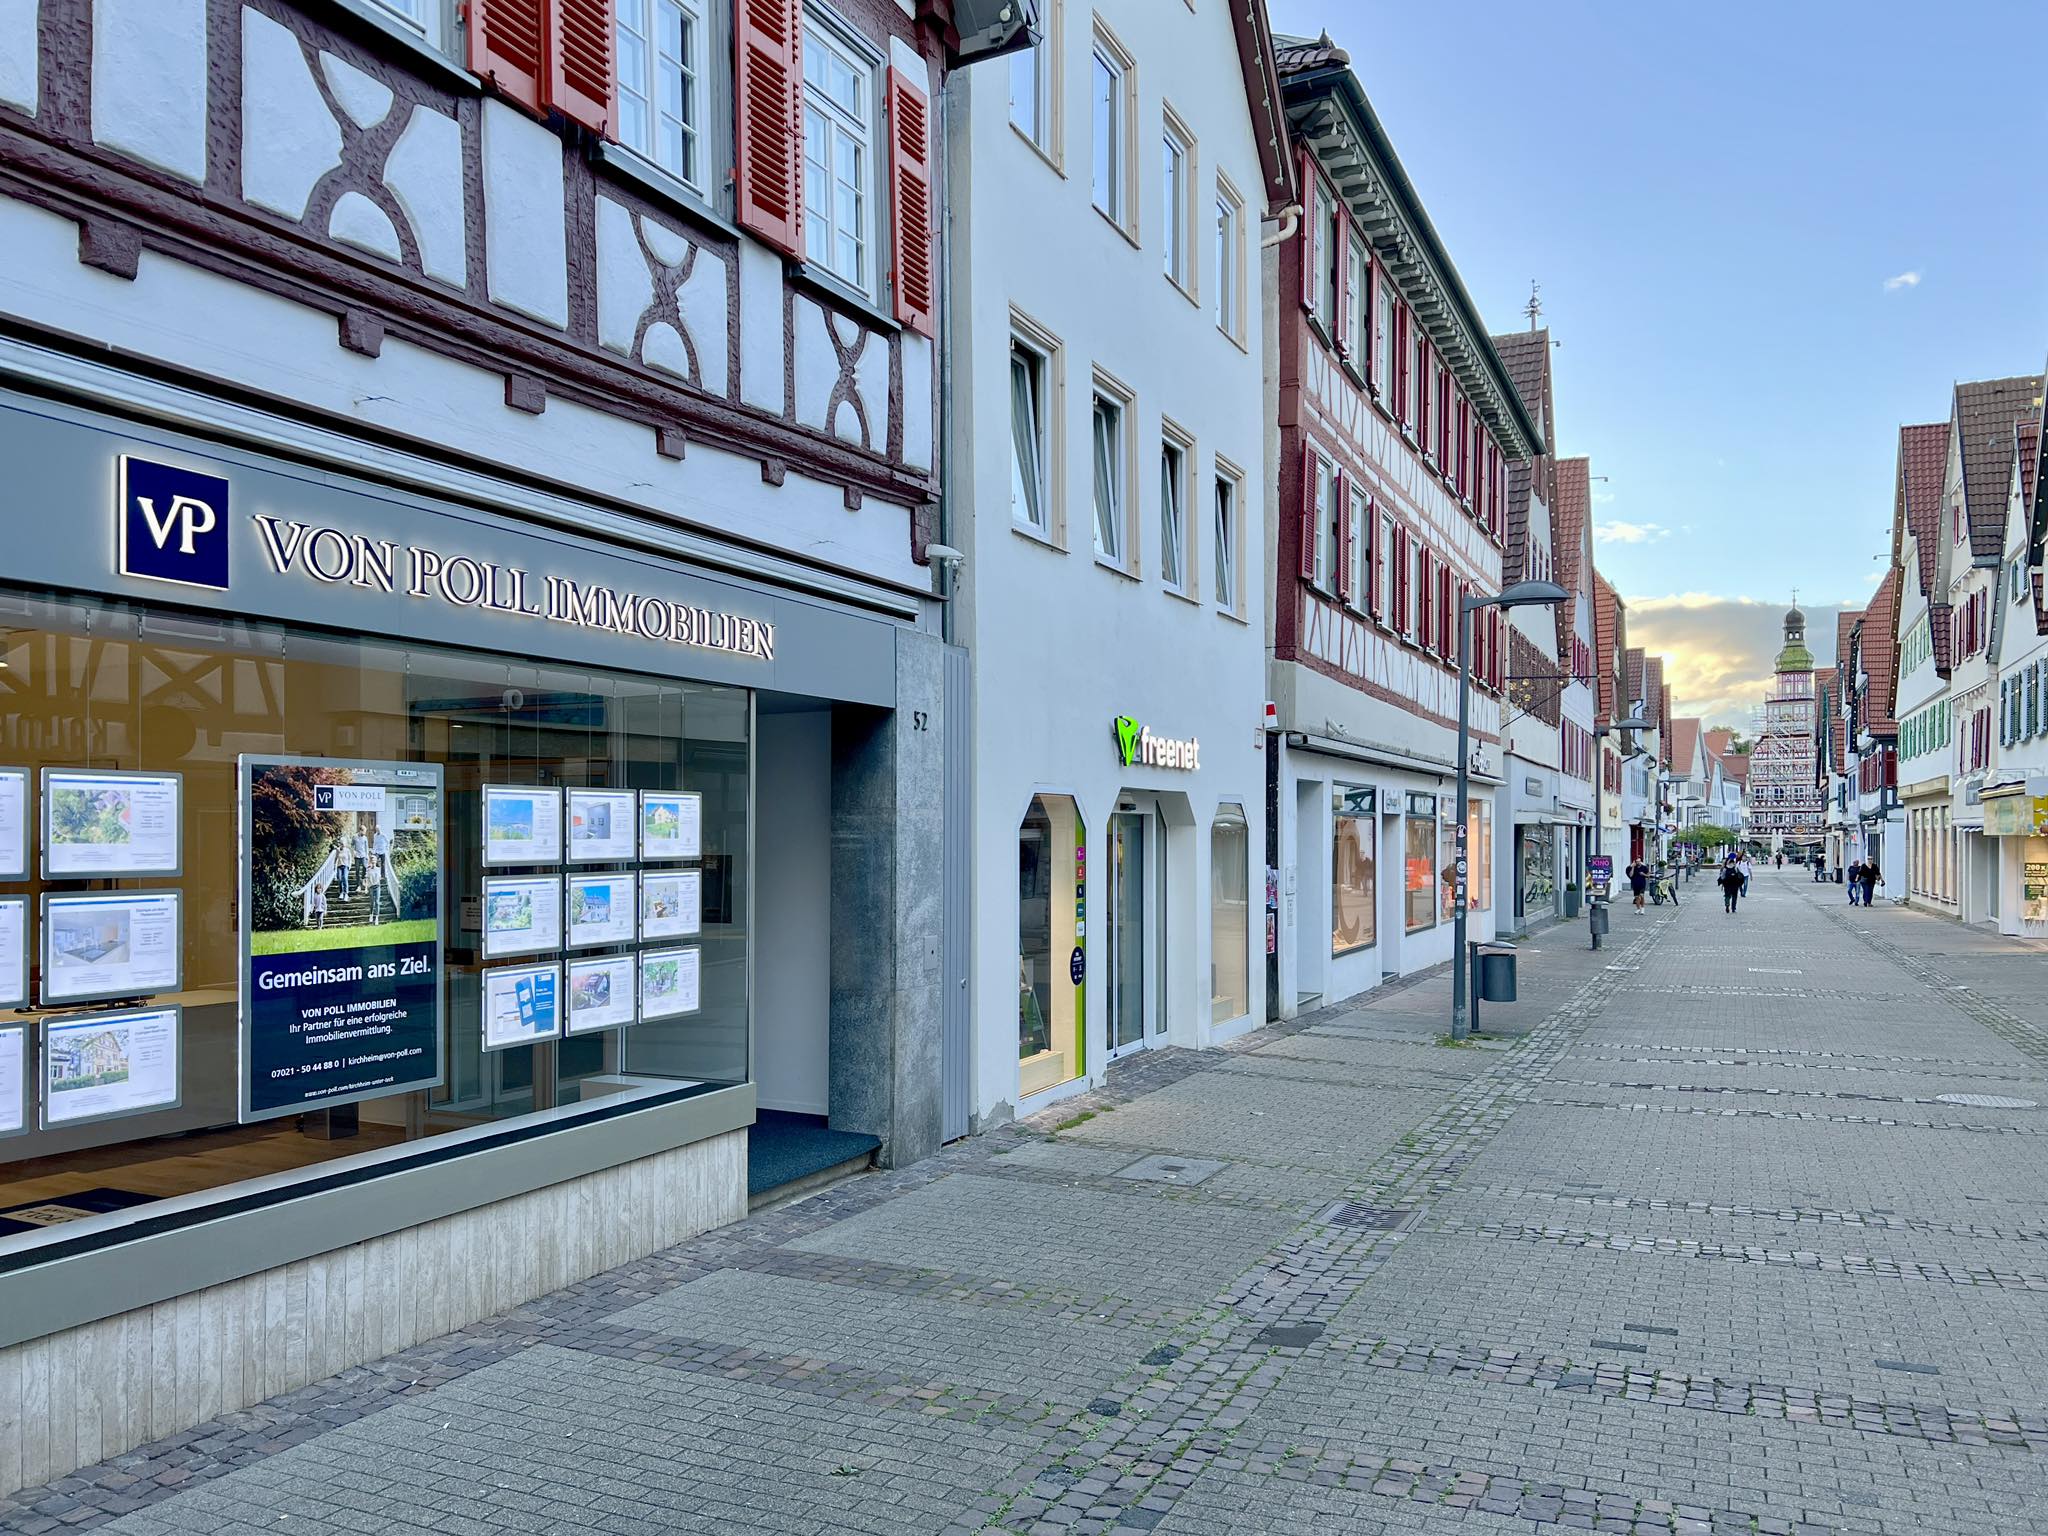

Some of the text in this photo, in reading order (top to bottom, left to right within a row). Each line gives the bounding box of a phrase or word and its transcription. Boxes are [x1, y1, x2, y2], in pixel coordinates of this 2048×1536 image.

[136, 494, 216, 554] VP
[253, 513, 775, 660] VON POLL IMMOBILIEN
[913, 710, 928, 731] 52
[1140, 725, 1201, 770] freenet
[318, 791, 332, 803] VP
[339, 791, 382, 800] VON POLL
[259, 955, 431, 990] Gemeinsam ans Ziel.
[302, 999, 397, 1019] VON POLL IMMOBILIEN
[289, 1010, 407, 1034] Ihr Partner für eine erfolgreiche
[305, 1025, 393, 1044] Immobilienvermittlung.
[271, 1067, 295, 1078] 07021
[301, 1065, 311, 1074] 50
[312, 1063, 322, 1072] 44
[323, 1061, 333, 1070] 88
[334, 1060, 340, 1068] 0
[348, 1047, 422, 1065] kirchheim@von-poll.com
